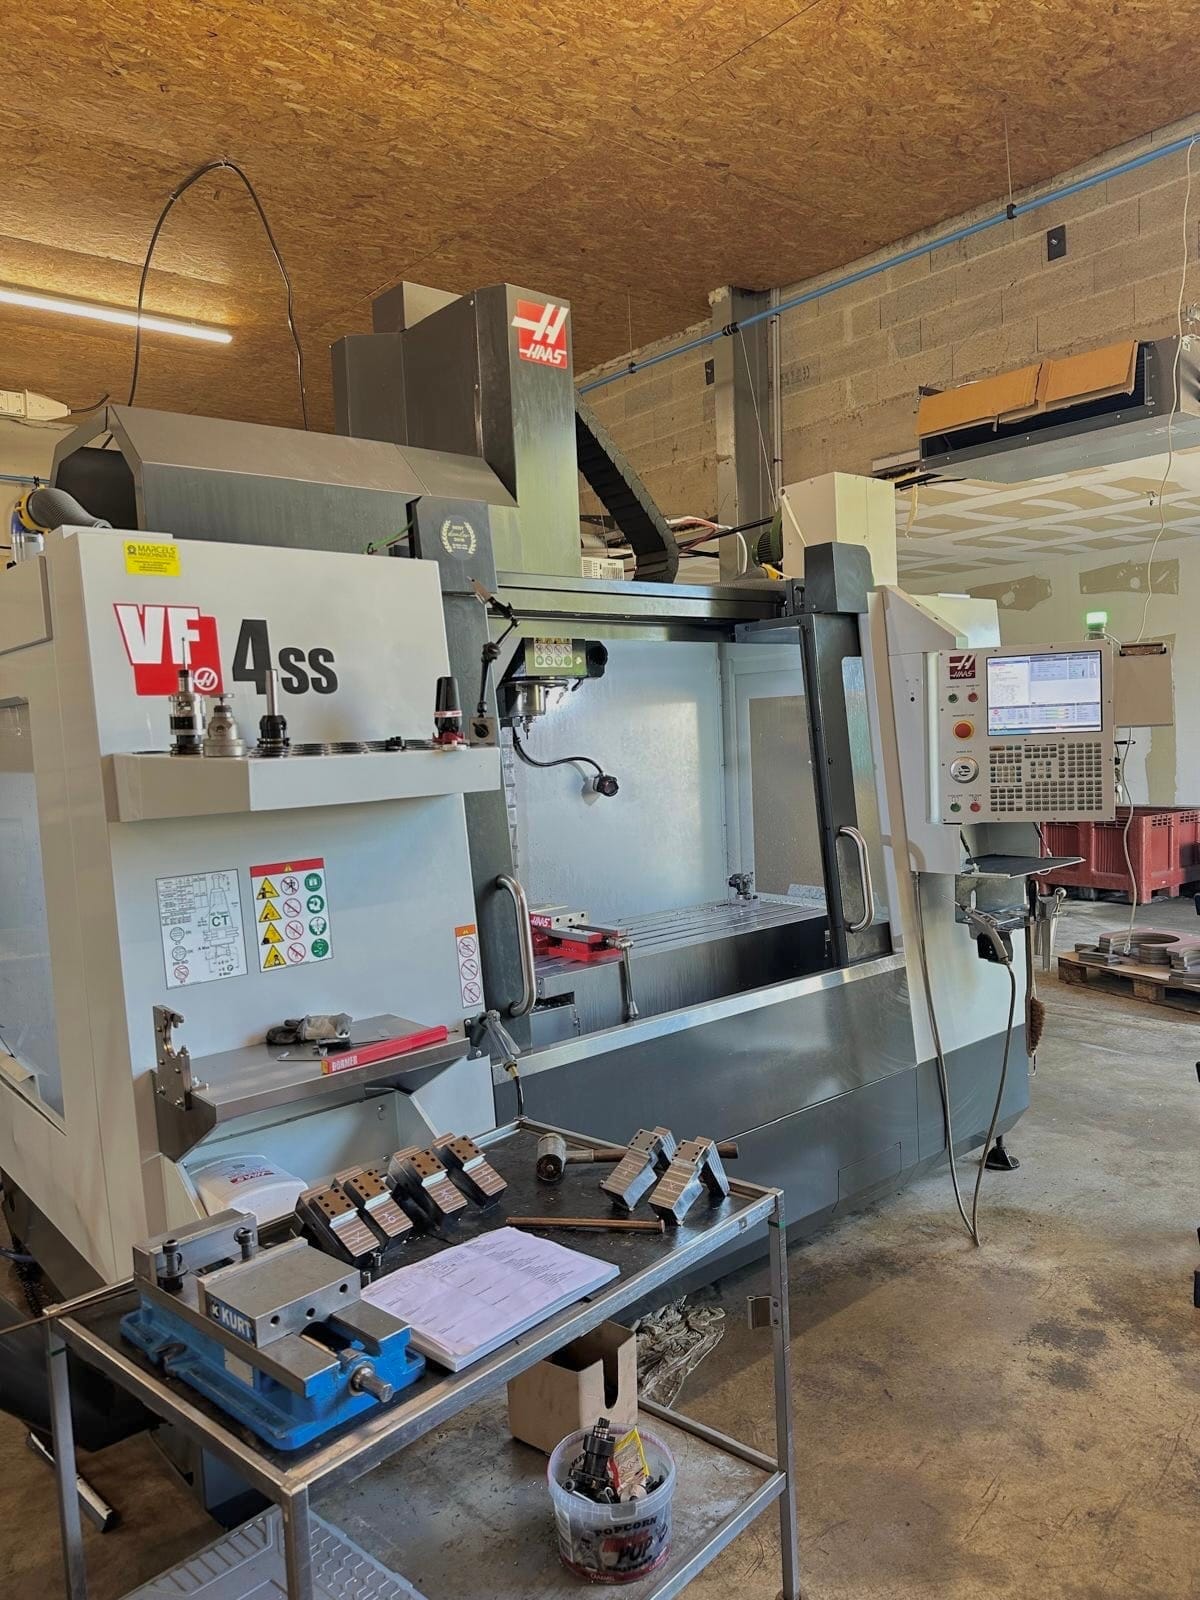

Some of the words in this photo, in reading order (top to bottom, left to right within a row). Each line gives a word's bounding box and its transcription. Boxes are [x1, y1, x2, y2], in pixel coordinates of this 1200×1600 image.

[519, 343, 567, 364] HAAS
[113, 604, 200, 665] VF
[211, 914, 230, 927] CT
[332, 1055, 358, 1071] DORMER
[221, 1306, 252, 1338] KURT
[593, 1515, 658, 1537] POPCORN
